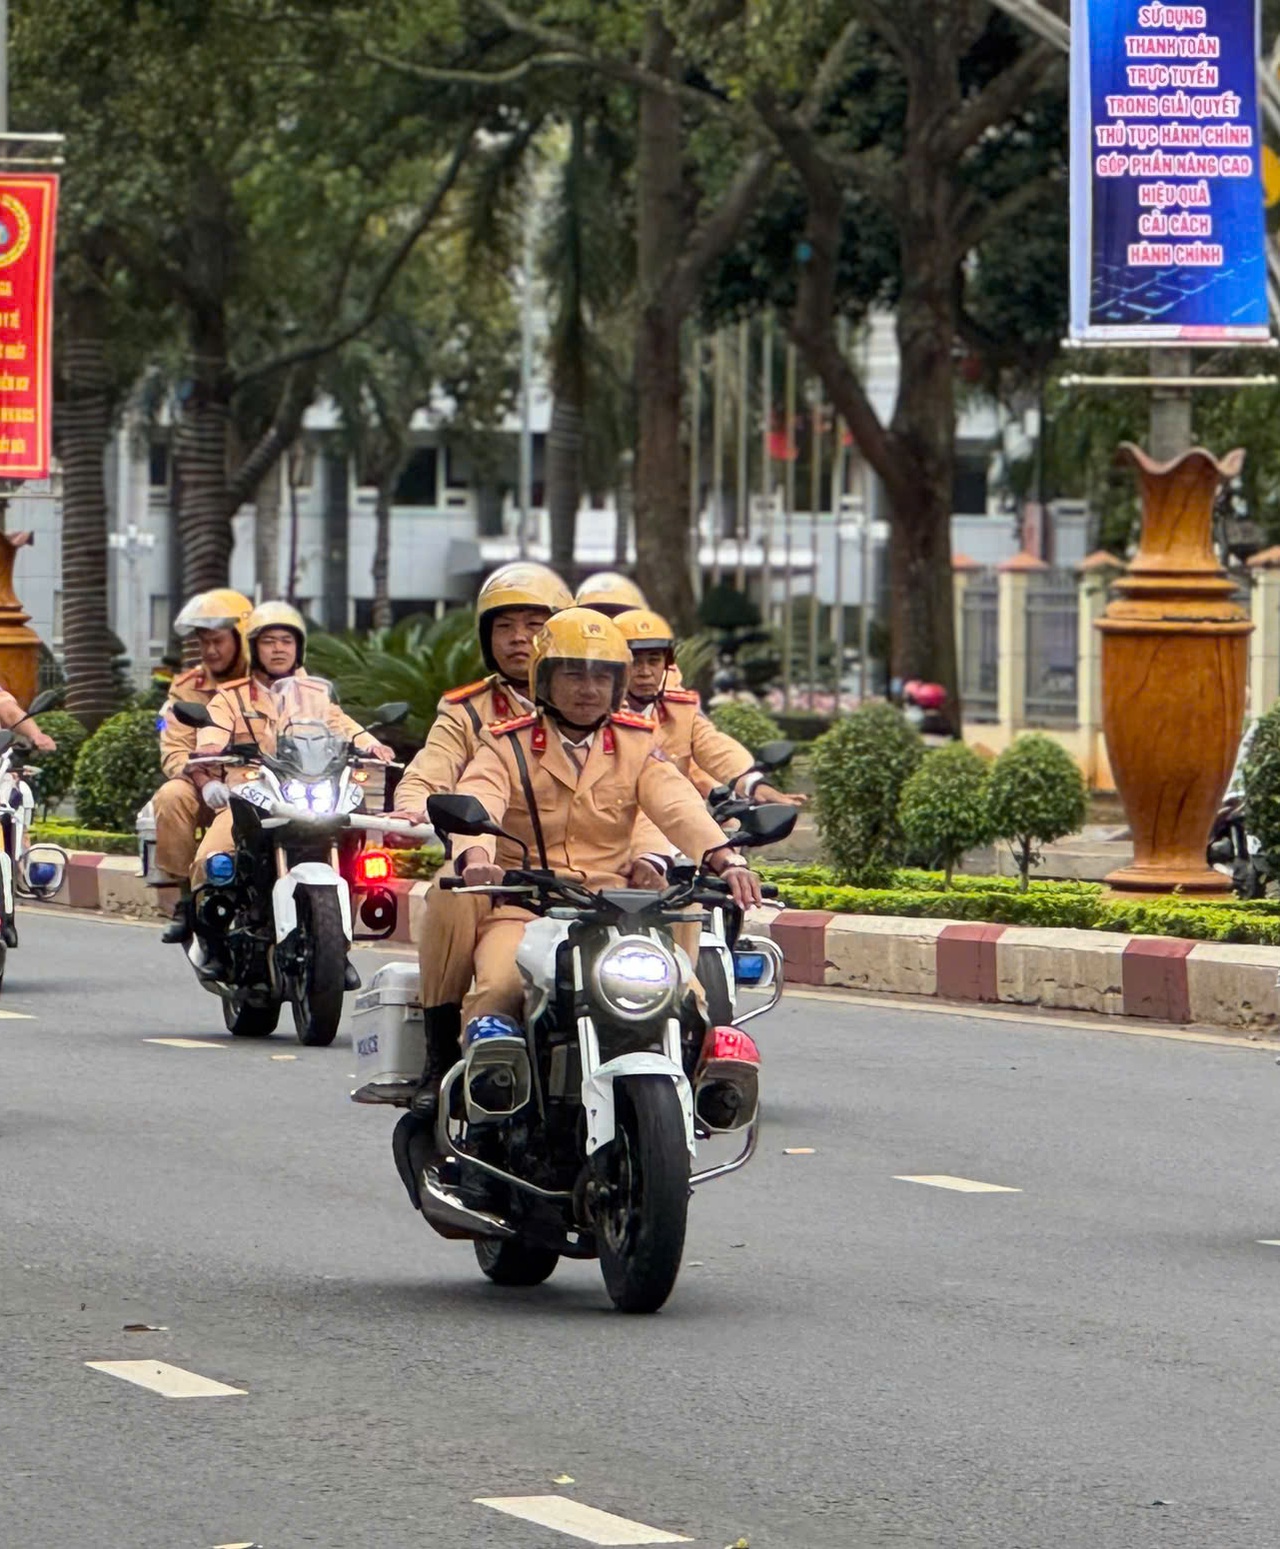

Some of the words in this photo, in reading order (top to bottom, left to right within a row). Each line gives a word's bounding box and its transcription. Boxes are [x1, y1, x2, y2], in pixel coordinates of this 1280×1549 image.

[1164, 6, 1206, 30] DỤNG
[1125, 36, 1177, 57] THANH
[1127, 64, 1168, 90] TRỰC
[1170, 62, 1219, 87] TUYẾN
[1106, 94, 1159, 116] TRONG
[1160, 90, 1190, 116] GIẢI
[1191, 90, 1241, 118] QUYẾT
[1095, 120, 1126, 146] THỦ
[1127, 126, 1158, 149] TỤC
[1160, 122, 1202, 146] HÀNH
[1203, 122, 1252, 147] CHÍNH
[1097, 152, 1127, 176] GÓP
[1129, 149, 1175, 176] PHẦN
[1219, 155, 1253, 176] CAO
[1139, 181, 1176, 209] HIỆU
[1177, 179, 1211, 207] QUẢ
[1139, 209, 1167, 235] CẢI
[1169, 211, 1211, 235] CÁCH
[1128, 241, 1172, 265] HÀNH
[1174, 241, 1223, 265] CHÍNH
[241, 785, 270, 806] CSGT
